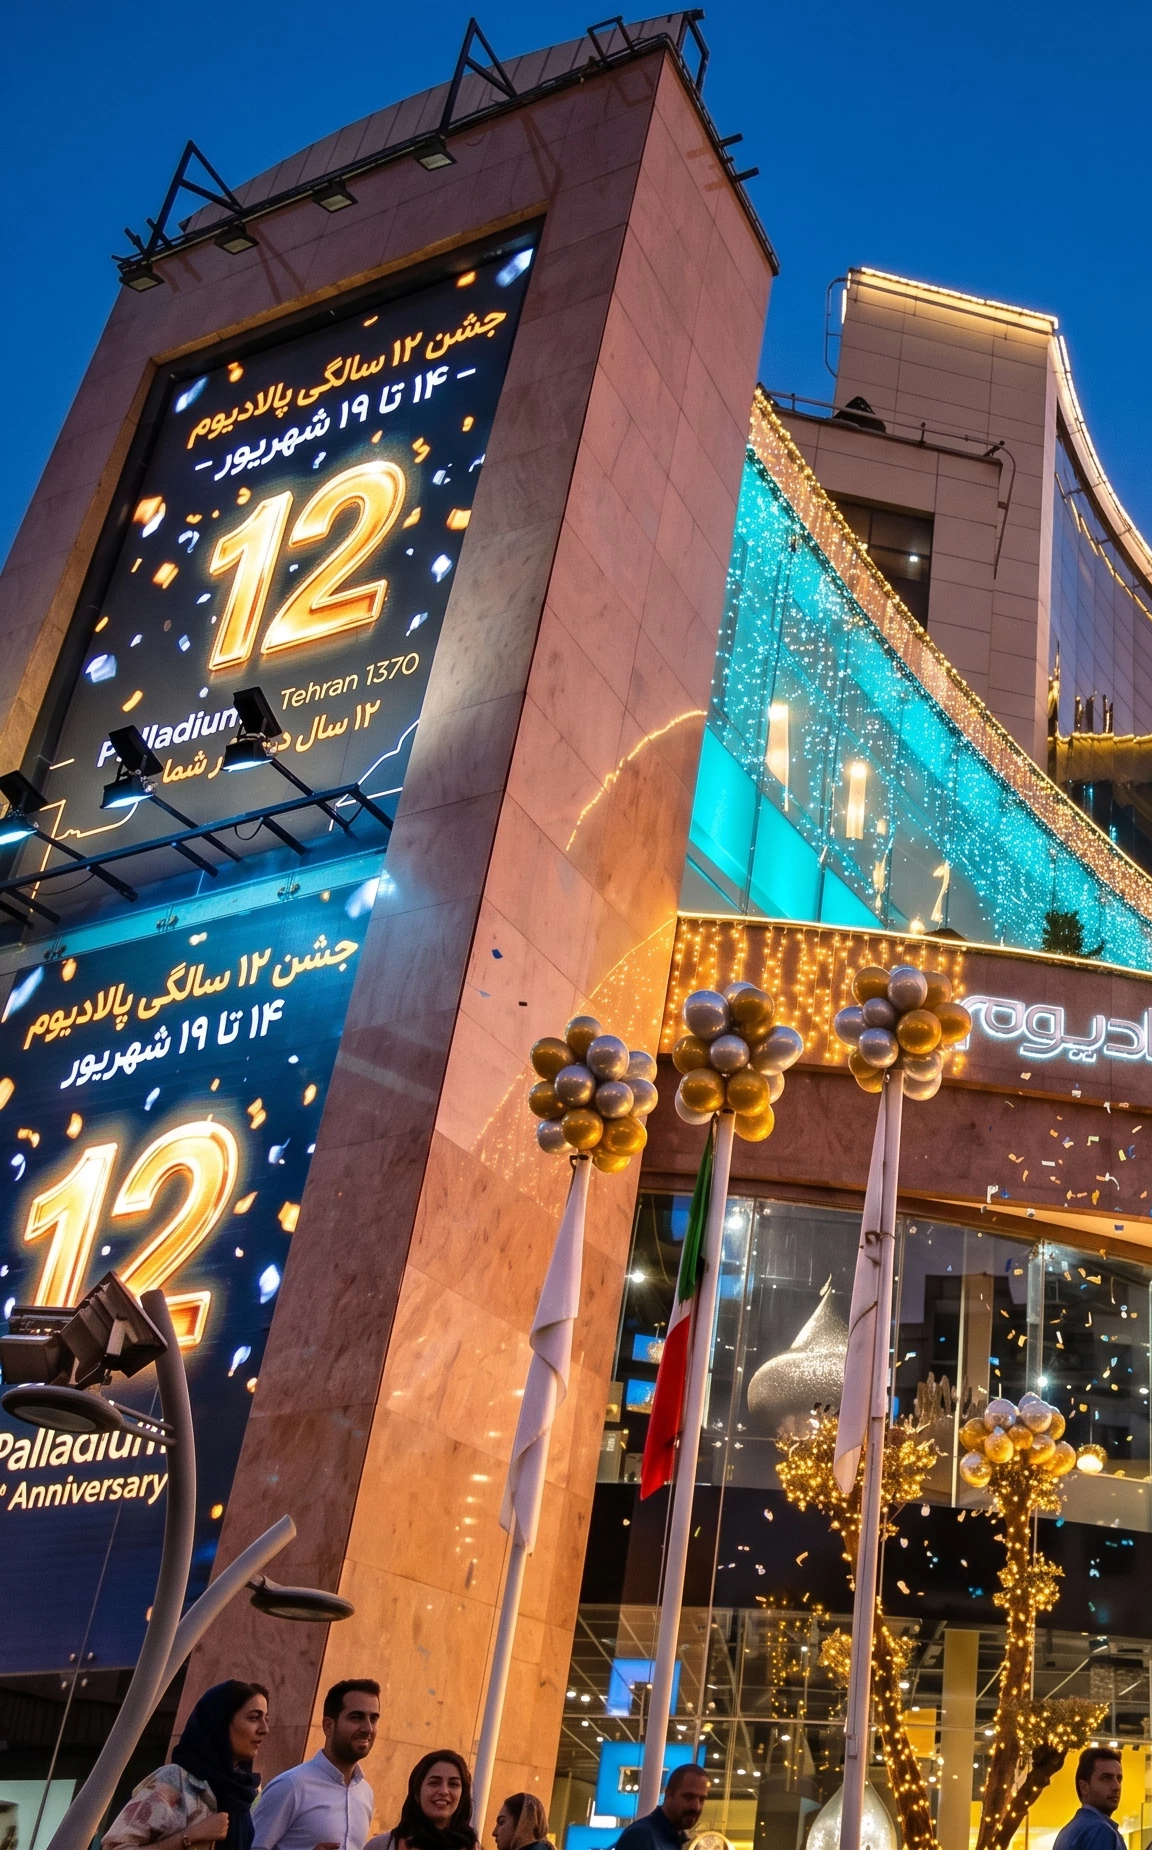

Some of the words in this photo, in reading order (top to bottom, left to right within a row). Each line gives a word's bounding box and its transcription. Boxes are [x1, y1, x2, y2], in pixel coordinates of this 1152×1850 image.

[392, 331, 423, 367] ۱۲
[424, 311, 507, 360] جشن
[296, 352, 385, 407] سالگی
[378, 381, 405, 414] تا
[412, 365, 449, 404] ۱۴
[186, 381, 293, 450] پالادیوم
[339, 394, 369, 429] ۱۹
[213, 408, 331, 482] شهریور
[207, 459, 407, 672] 12
[280, 674, 359, 711] Tehran
[365, 651, 420, 686] 1370
[294, 713, 349, 753] سال
[353, 699, 381, 732] ۱۲
[162, 750, 208, 785] شما
[237, 947, 272, 987] ۱۲
[272, 934, 359, 989] جشن
[137, 961, 231, 1020] سالگی
[23, 983, 134, 1050] پالادیوم
[179, 1016, 208, 1055] ۱۹
[217, 1010, 244, 1045] تا
[249, 998, 286, 1040] ۱۴
[60, 1025, 172, 1090] شهریور
[25, 1121, 238, 1348] 12
[7, 1473, 168, 1511] Anniversary
